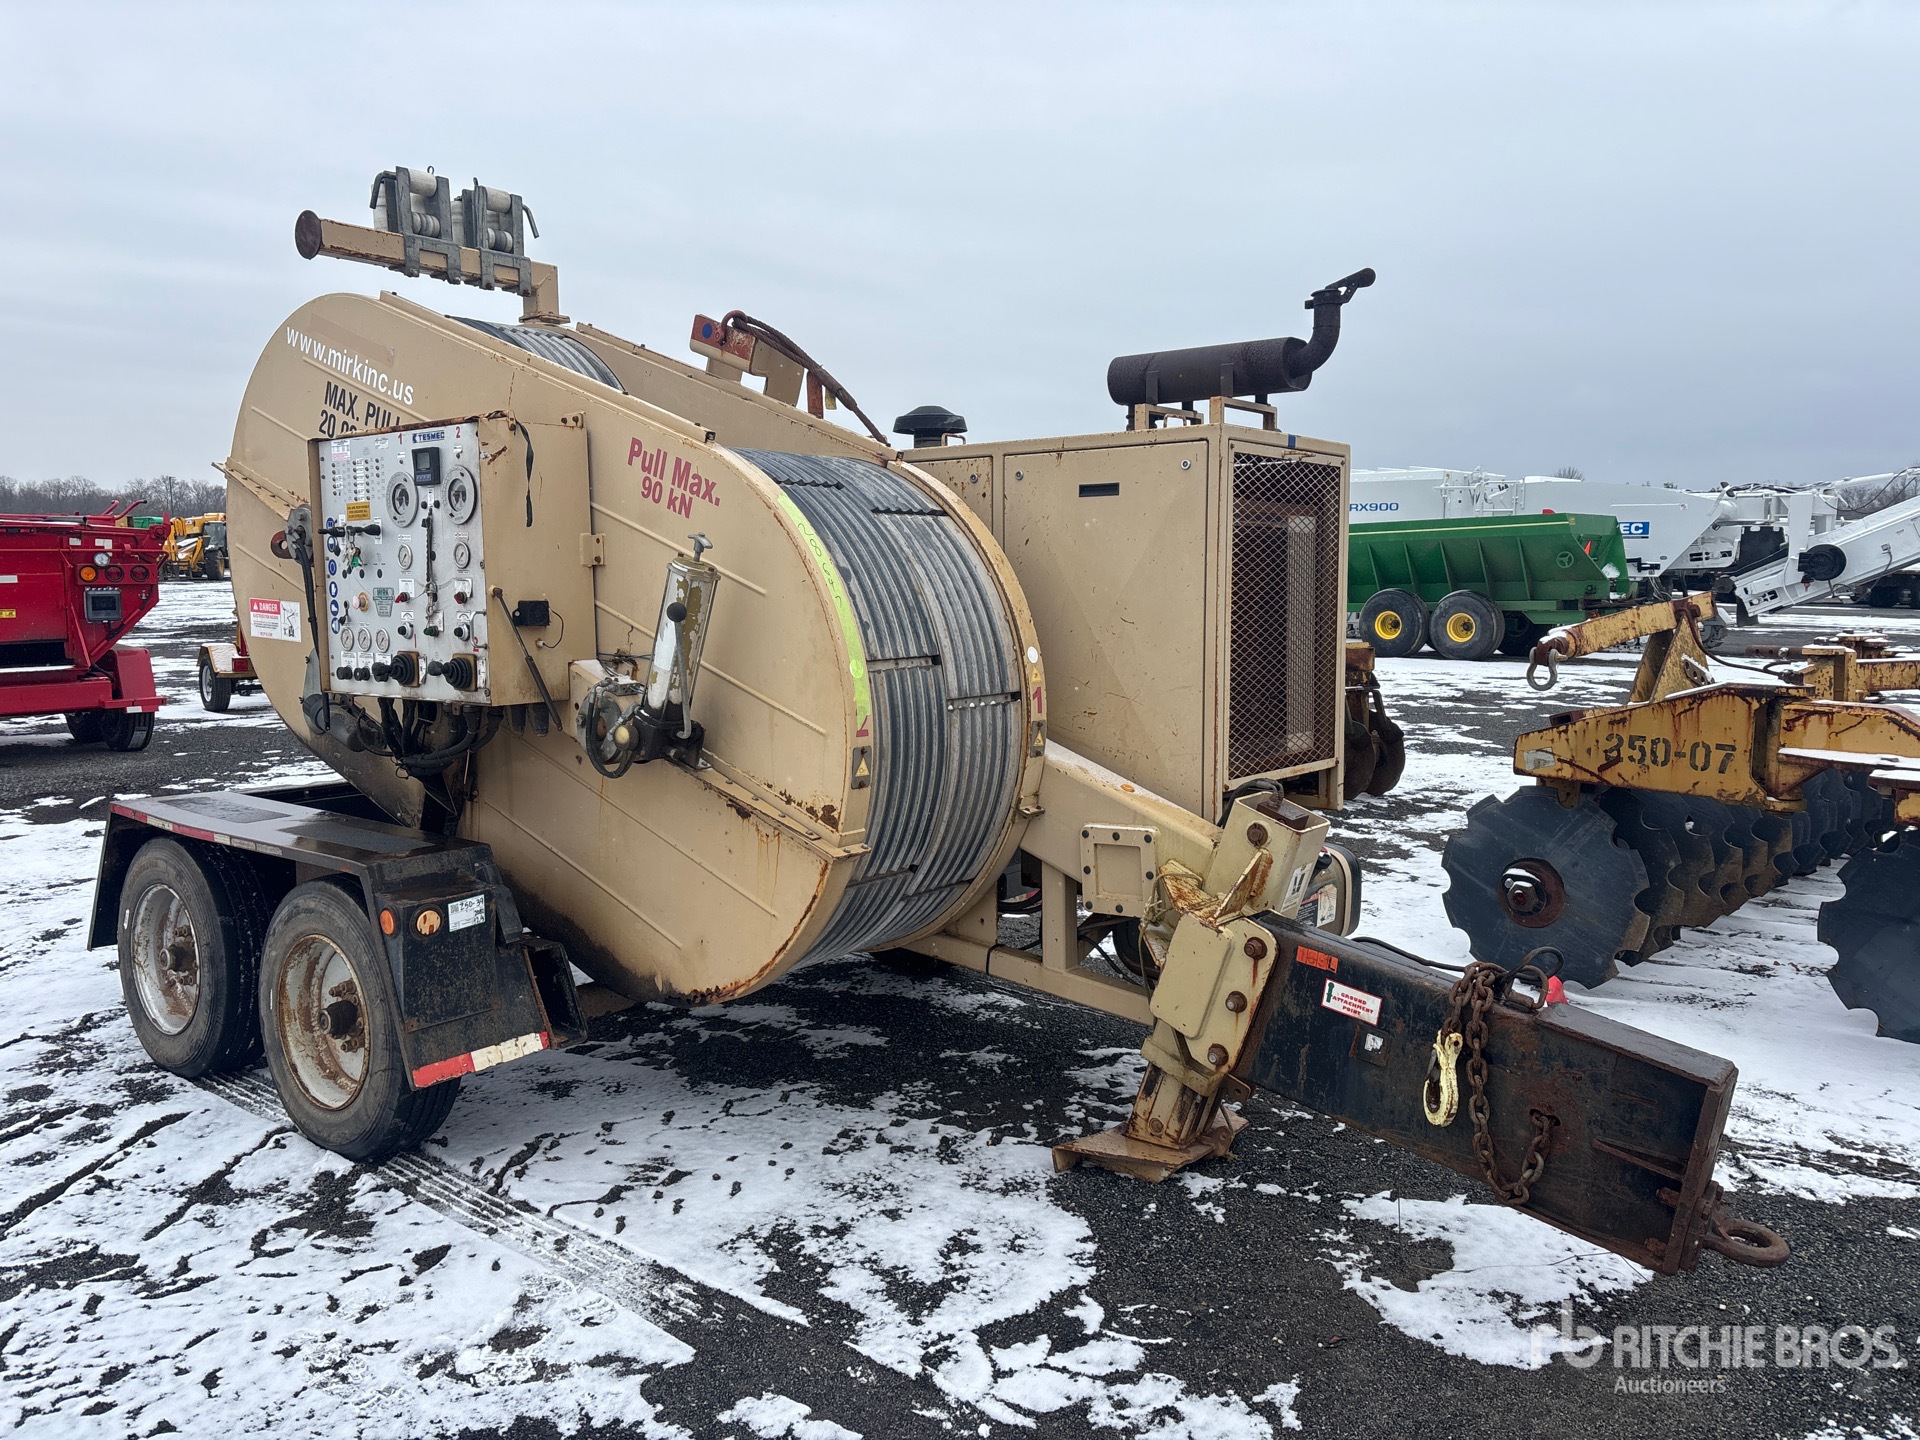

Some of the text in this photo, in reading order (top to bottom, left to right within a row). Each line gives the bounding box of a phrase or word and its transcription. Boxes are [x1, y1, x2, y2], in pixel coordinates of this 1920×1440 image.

[286, 326, 415, 406] www.mirkinc.us
[324, 380, 360, 422] MAX.
[318, 409, 337, 439] 20
[455, 426, 461, 439] 2
[397, 432, 403, 445] 1
[418, 431, 445, 441] TESMEC
[627, 436, 721, 507] Pull Max.
[641, 475, 694, 519] 90 kN
[1348, 502, 1400, 512] RX900
[258, 602, 279, 613] DANGER
[1032, 686, 1043, 714] 1
[1602, 732, 1737, 775] 250-07
[1332, 995, 1374, 1014] ATTACHMENT
[1340, 992, 1367, 1005] GROUND
[1342, 1005, 1361, 1015] POINT
